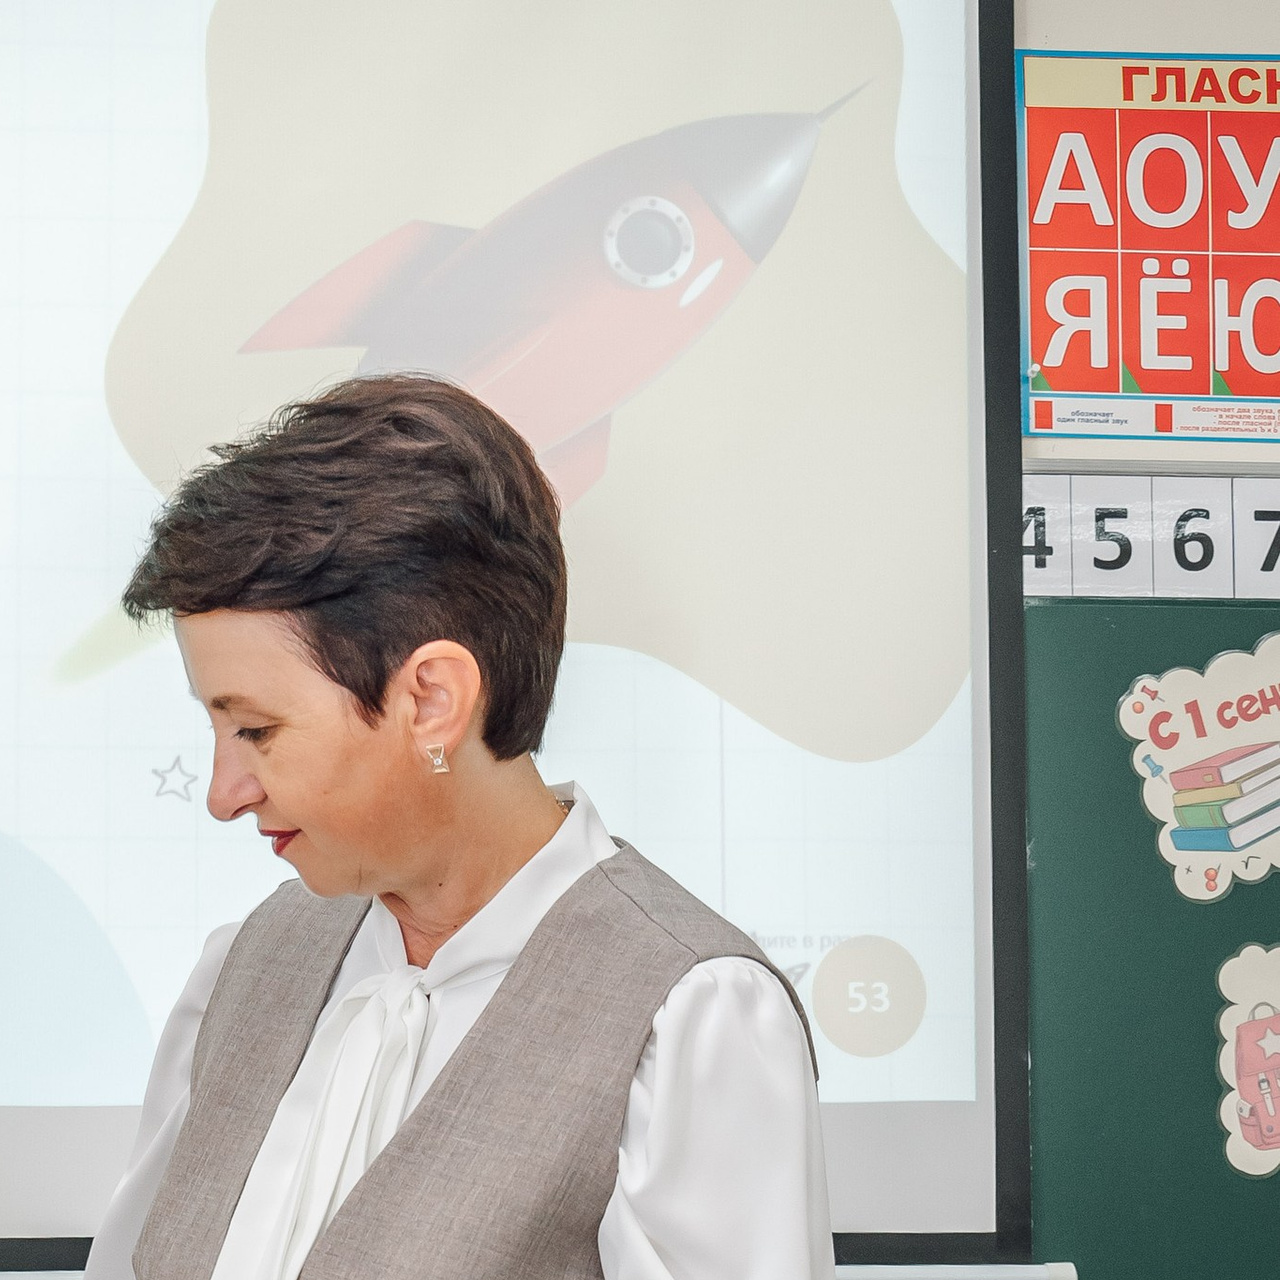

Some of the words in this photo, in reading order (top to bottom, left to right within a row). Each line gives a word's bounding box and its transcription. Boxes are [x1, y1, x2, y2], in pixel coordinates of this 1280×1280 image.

[1032, 132, 1115, 226] А
[1125, 133, 1204, 228] О
[1042, 275, 1109, 369] Я
[1139, 257, 1193, 371] Ё
[1022, 506, 1053, 568] 4
[1093, 508, 1132, 570] 5
[1173, 508, 1214, 571] 6
[1185, 699, 1208, 738] 1
[1216, 682, 1280, 730] сен
[847, 982, 891, 1012] 53
